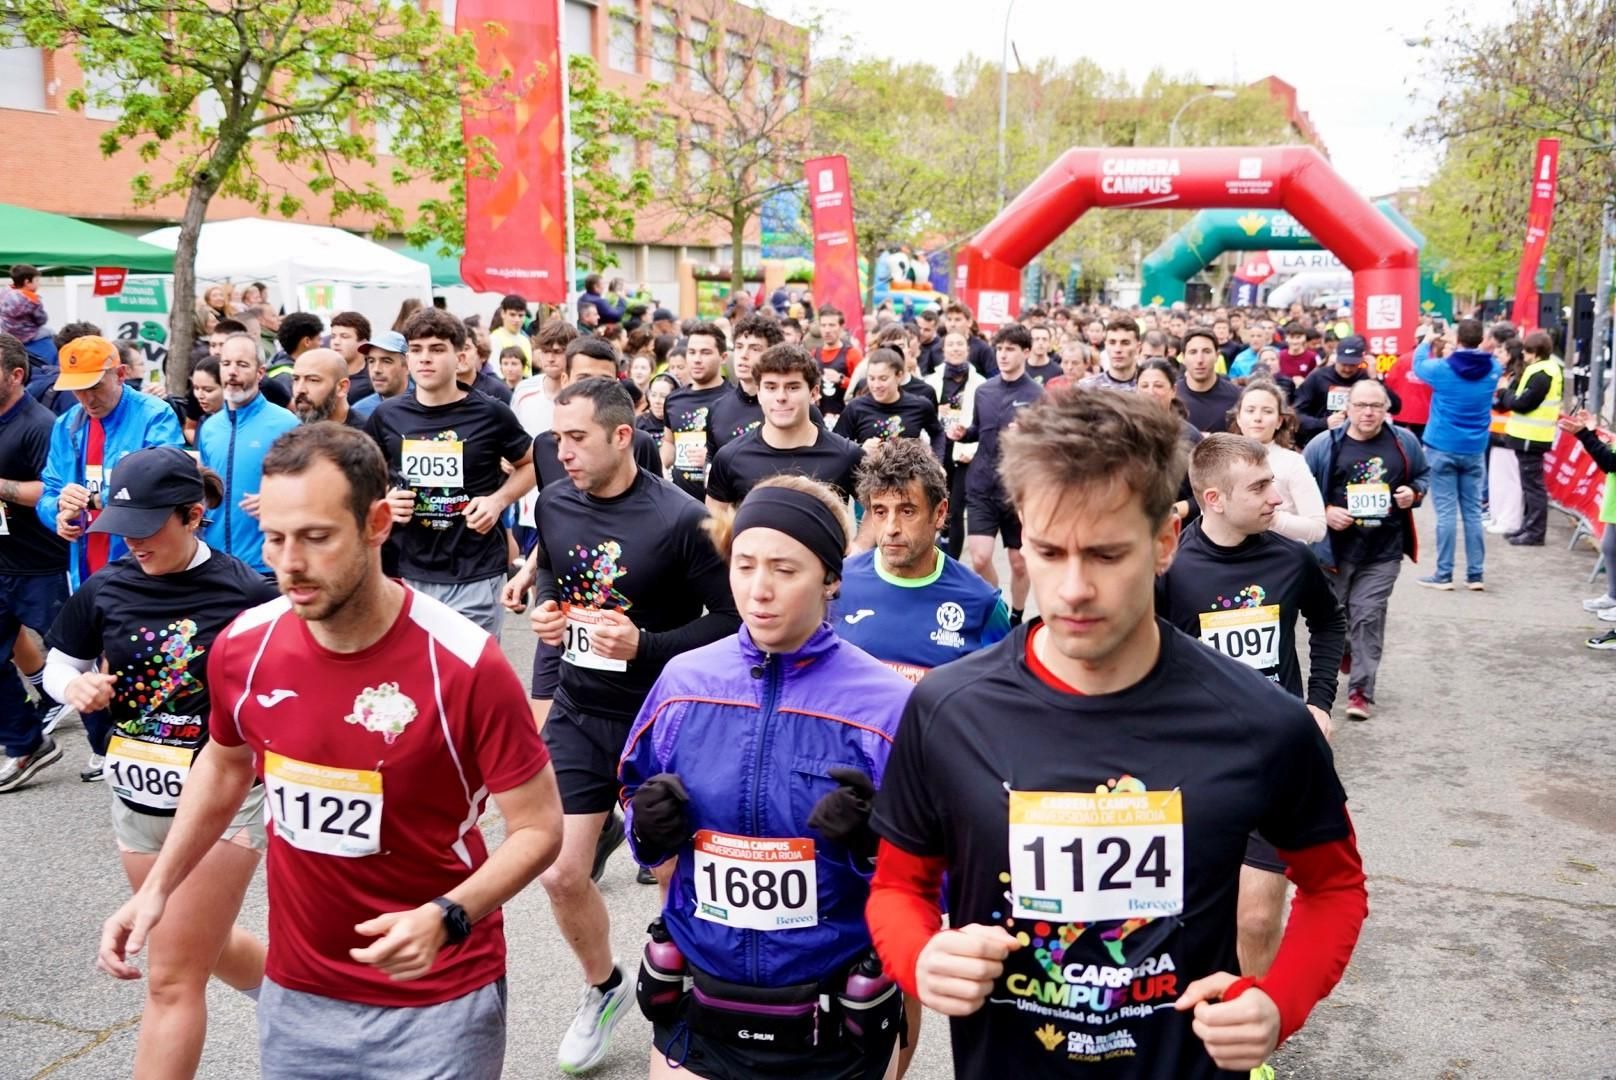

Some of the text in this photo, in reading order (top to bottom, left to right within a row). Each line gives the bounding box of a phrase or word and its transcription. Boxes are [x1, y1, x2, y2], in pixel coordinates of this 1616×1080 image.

[1102, 158, 1180, 176] CARRERA
[1102, 177, 1171, 194] CAMPUS
[1282, 255, 1306, 267] LA
[406, 456, 459, 477] 2053
[414, 503, 453, 513] AMPUS
[430, 495, 470, 504] CARRERA
[1351, 494, 1388, 509] 3015
[566, 624, 590, 653] 16
[1208, 626, 1276, 658] 1097
[110, 761, 182, 798] 1086
[1040, 797, 1149, 810] CARRERA CAMPUS
[274, 786, 372, 840] 1122
[1024, 808, 1166, 822] UNIVERSIDAD DE LA RIOJA
[702, 842, 803, 860] UNIVERSIDAD DE LA RIOJA
[712, 834, 790, 851] CARRERA CAMPUS
[1023, 835, 1171, 892] 1124
[703, 862, 807, 911] 1680
[1128, 898, 1178, 911] Berceo
[776, 915, 814, 926] Berceo
[1132, 974, 1178, 1000] UR
[1015, 998, 1154, 1025] Universidad de La Rioja
